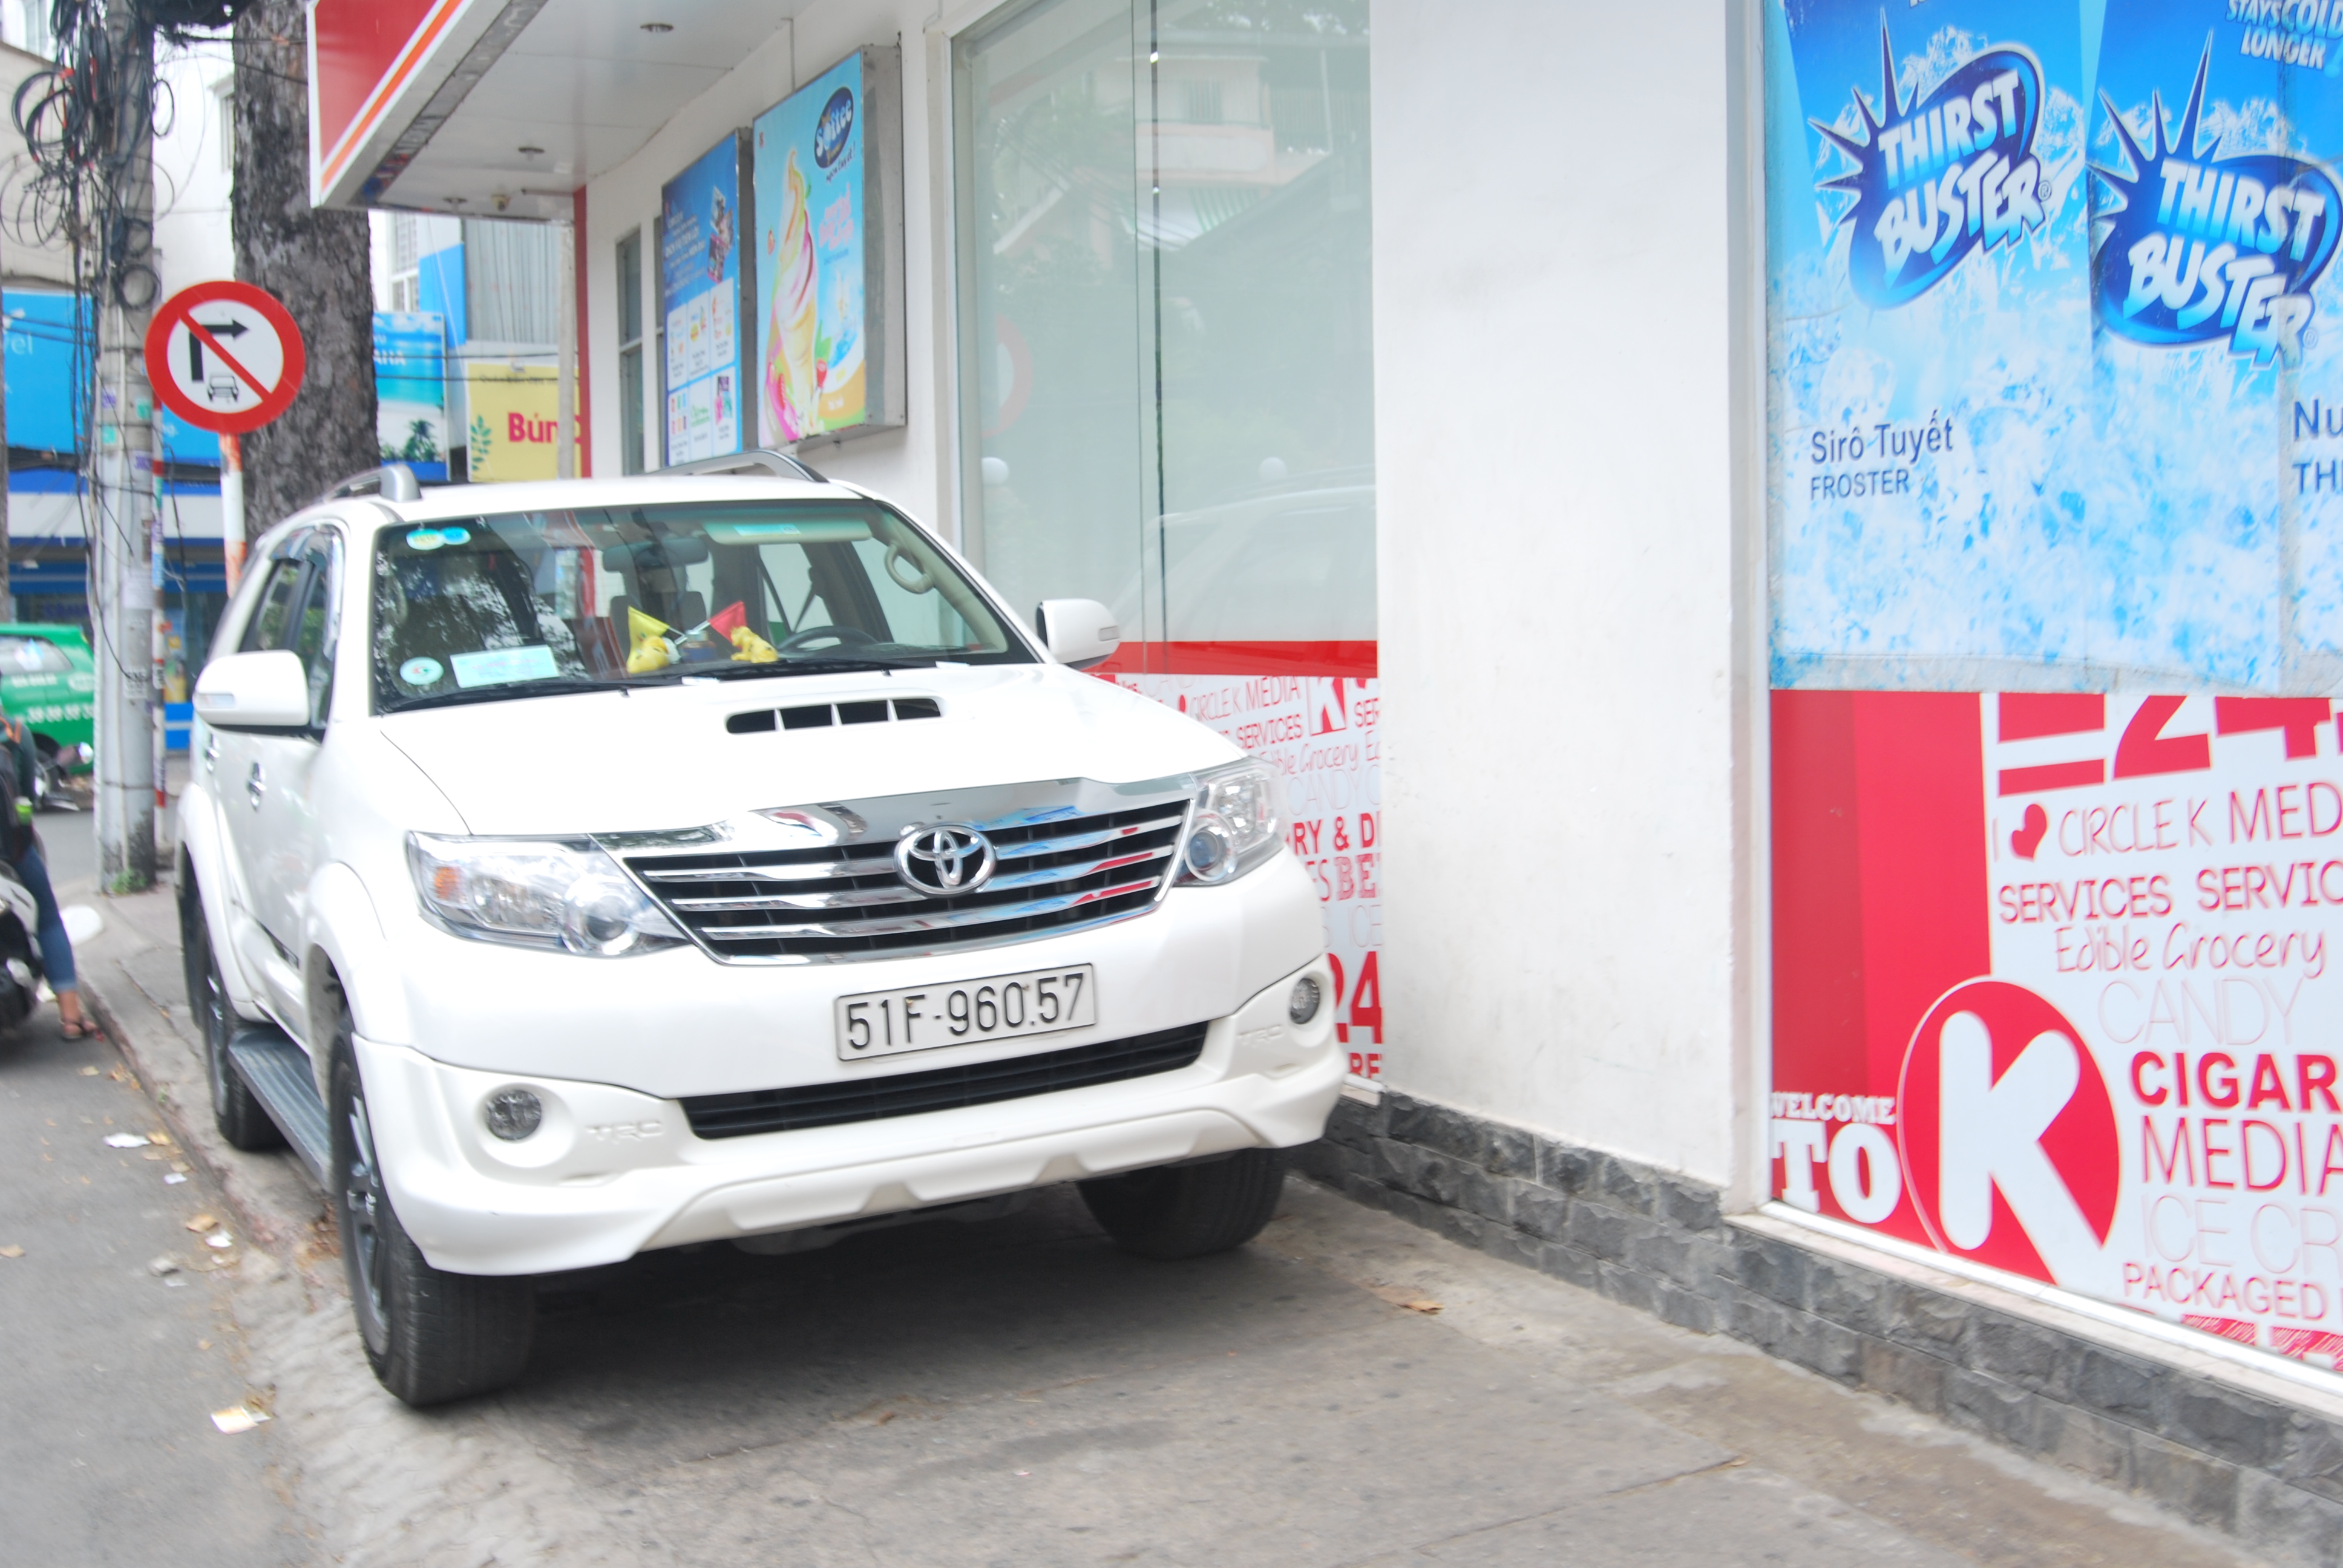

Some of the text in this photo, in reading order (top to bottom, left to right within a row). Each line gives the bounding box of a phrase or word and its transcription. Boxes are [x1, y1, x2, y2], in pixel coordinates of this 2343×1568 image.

[2225, 0, 2343, 39] STAYS COLD
[2240, 24, 2326, 70] LONGER
[1878, 69, 2019, 190] THIRST
[1873, 150, 2045, 290] BUSTER
[2157, 157, 2325, 261] THIRST
[2123, 232, 2313, 368] BUSTER
[1811, 408, 1953, 465] Sirô Tuyết
[1811, 469, 1910, 501] FROSTER
[1190, 688, 1231, 722] CIRCLE
[1245, 676, 1301, 711] MEDIA
[1236, 713, 1303, 750] SERVICES
[1286, 766, 1363, 816] CANDY
[2059, 797, 2178, 858] CIRCLE
[2187, 797, 2213, 847] K
[2229, 782, 2343, 844] MED
[1285, 818, 1322, 855] RY
[1334, 853, 1381, 900] BE
[1999, 860, 2343, 924] SERVICES SERVIC
[2054, 921, 2326, 979] Edible Grocery
[847, 973, 1084, 1050] 51F-960.57
[2098, 976, 2304, 1046] CANDY
[1771, 1091, 1896, 1125] WELCOME
[2128, 1051, 2343, 1114] CIGAR
[1771, 1010, 2103, 1284] TO K
[2141, 1115, 2343, 1197] MEDIA
[2141, 1193, 2343, 1279] ICE CR
[2122, 1261, 2328, 1321] PACKAGED
